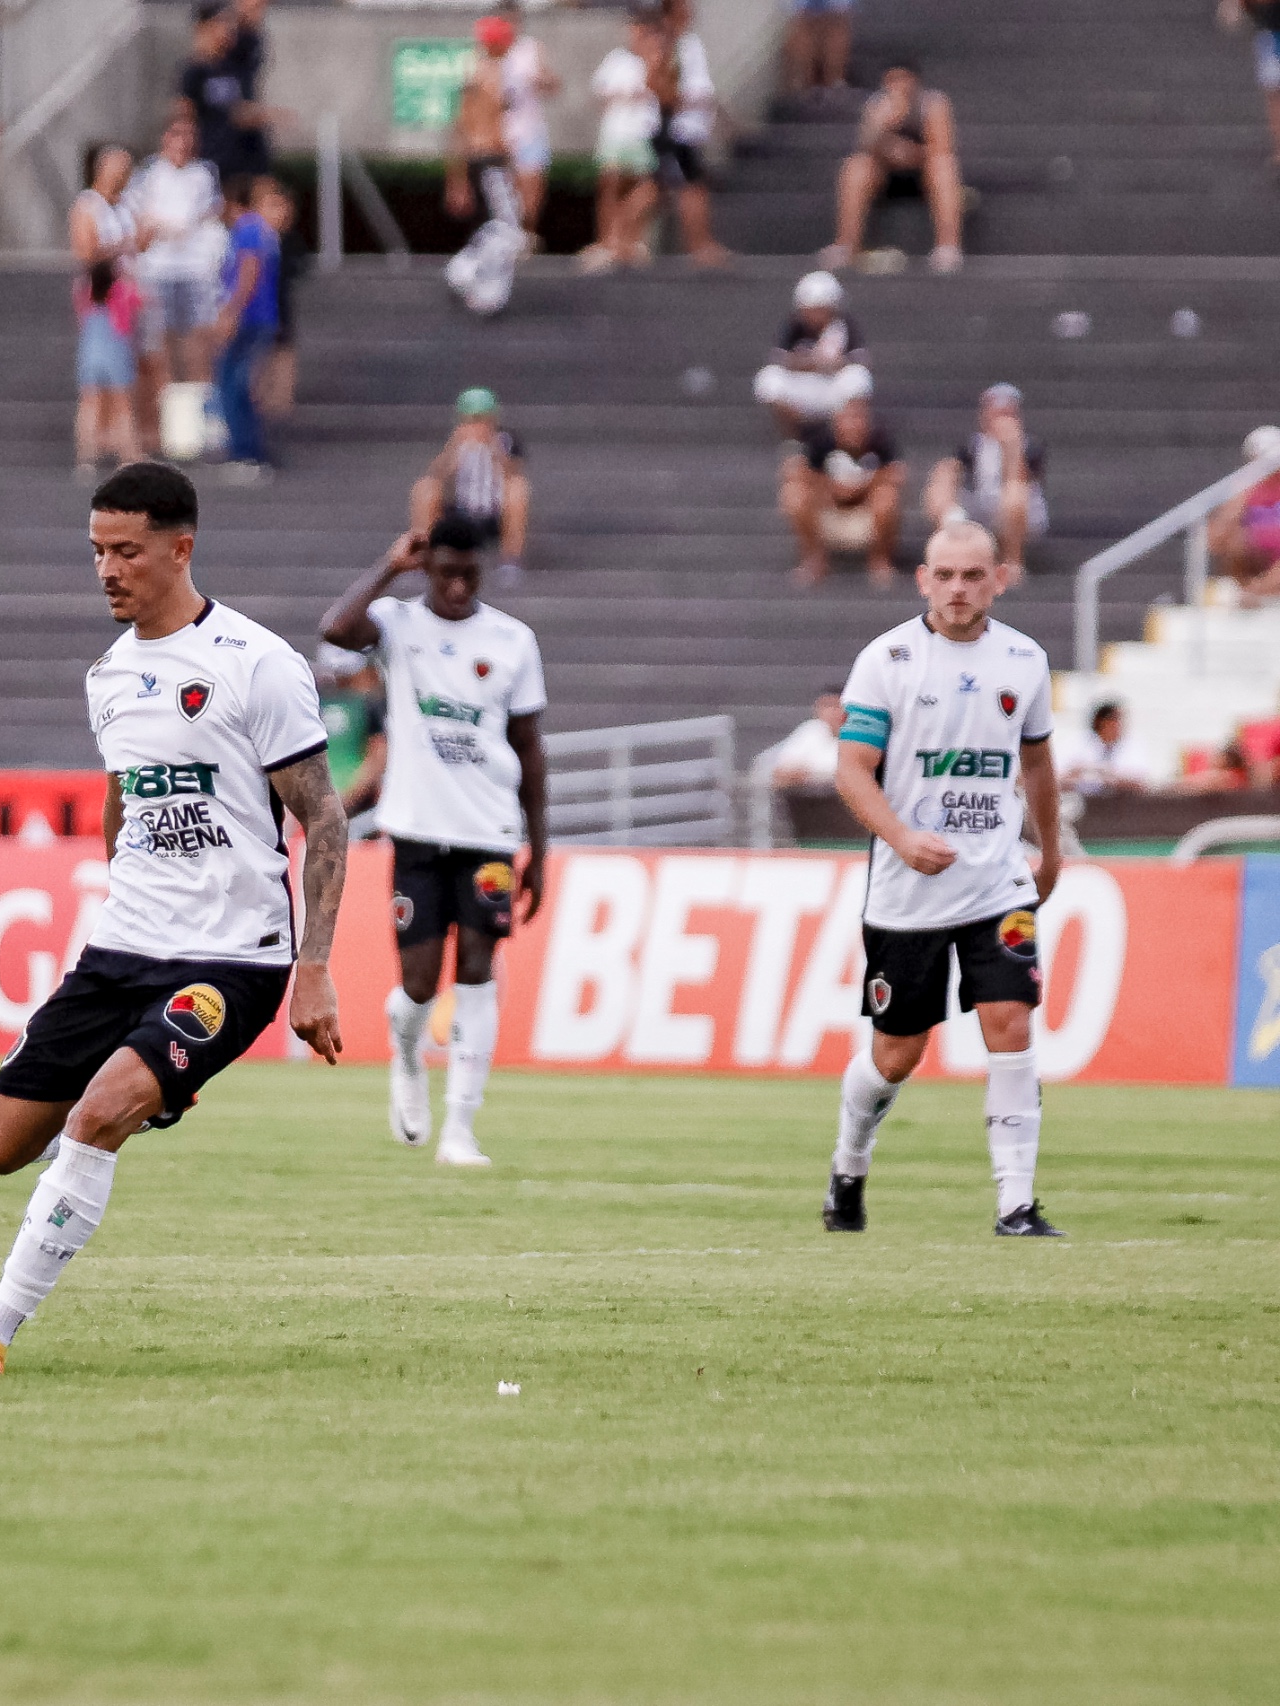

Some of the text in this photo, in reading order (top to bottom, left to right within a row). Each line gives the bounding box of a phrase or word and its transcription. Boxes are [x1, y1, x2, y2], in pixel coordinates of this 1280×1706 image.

[941, 790, 1001, 811] GAME
[140, 801, 212, 832] GAME
[943, 809, 1005, 830] ARENA
[152, 825, 234, 852] ARENA
